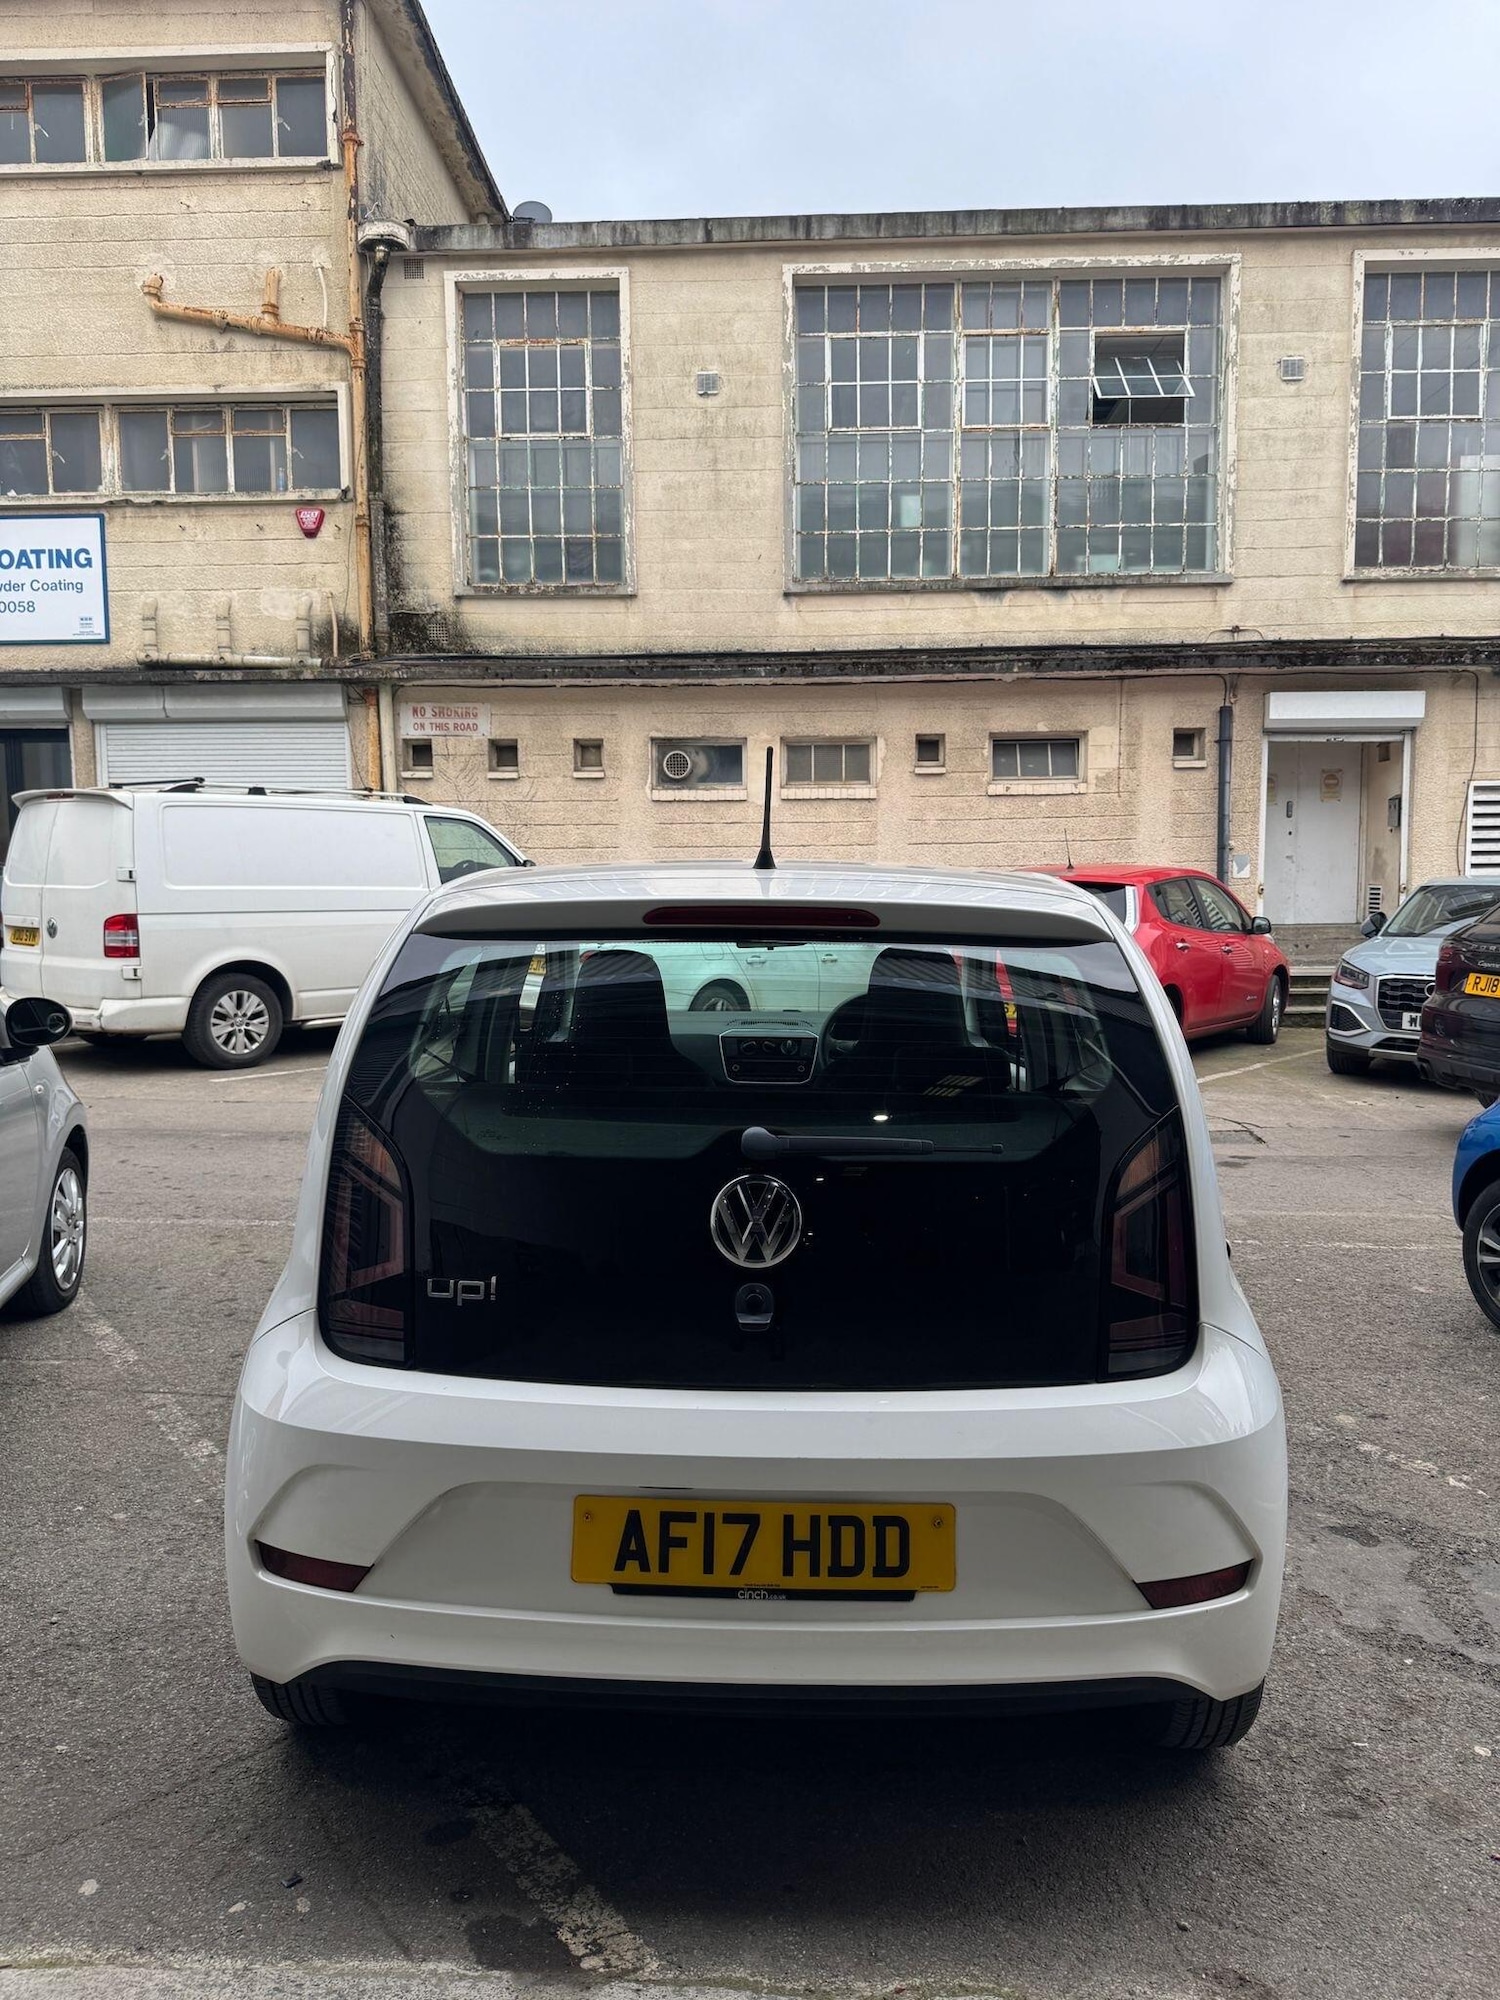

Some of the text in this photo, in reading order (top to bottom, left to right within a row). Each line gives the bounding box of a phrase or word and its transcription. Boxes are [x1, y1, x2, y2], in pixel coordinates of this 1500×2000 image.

[0, 548, 93, 569] OATING
[30, 579, 84, 594] Coating
[0, 600, 36, 613] 0058
[412, 705, 426, 718] NO
[413, 722, 479, 732] ON THIS ROAD
[1472, 975, 1500, 993] RJ18
[426, 1275, 497, 1307] up!
[613, 1508, 910, 1578] AF17 HDD
